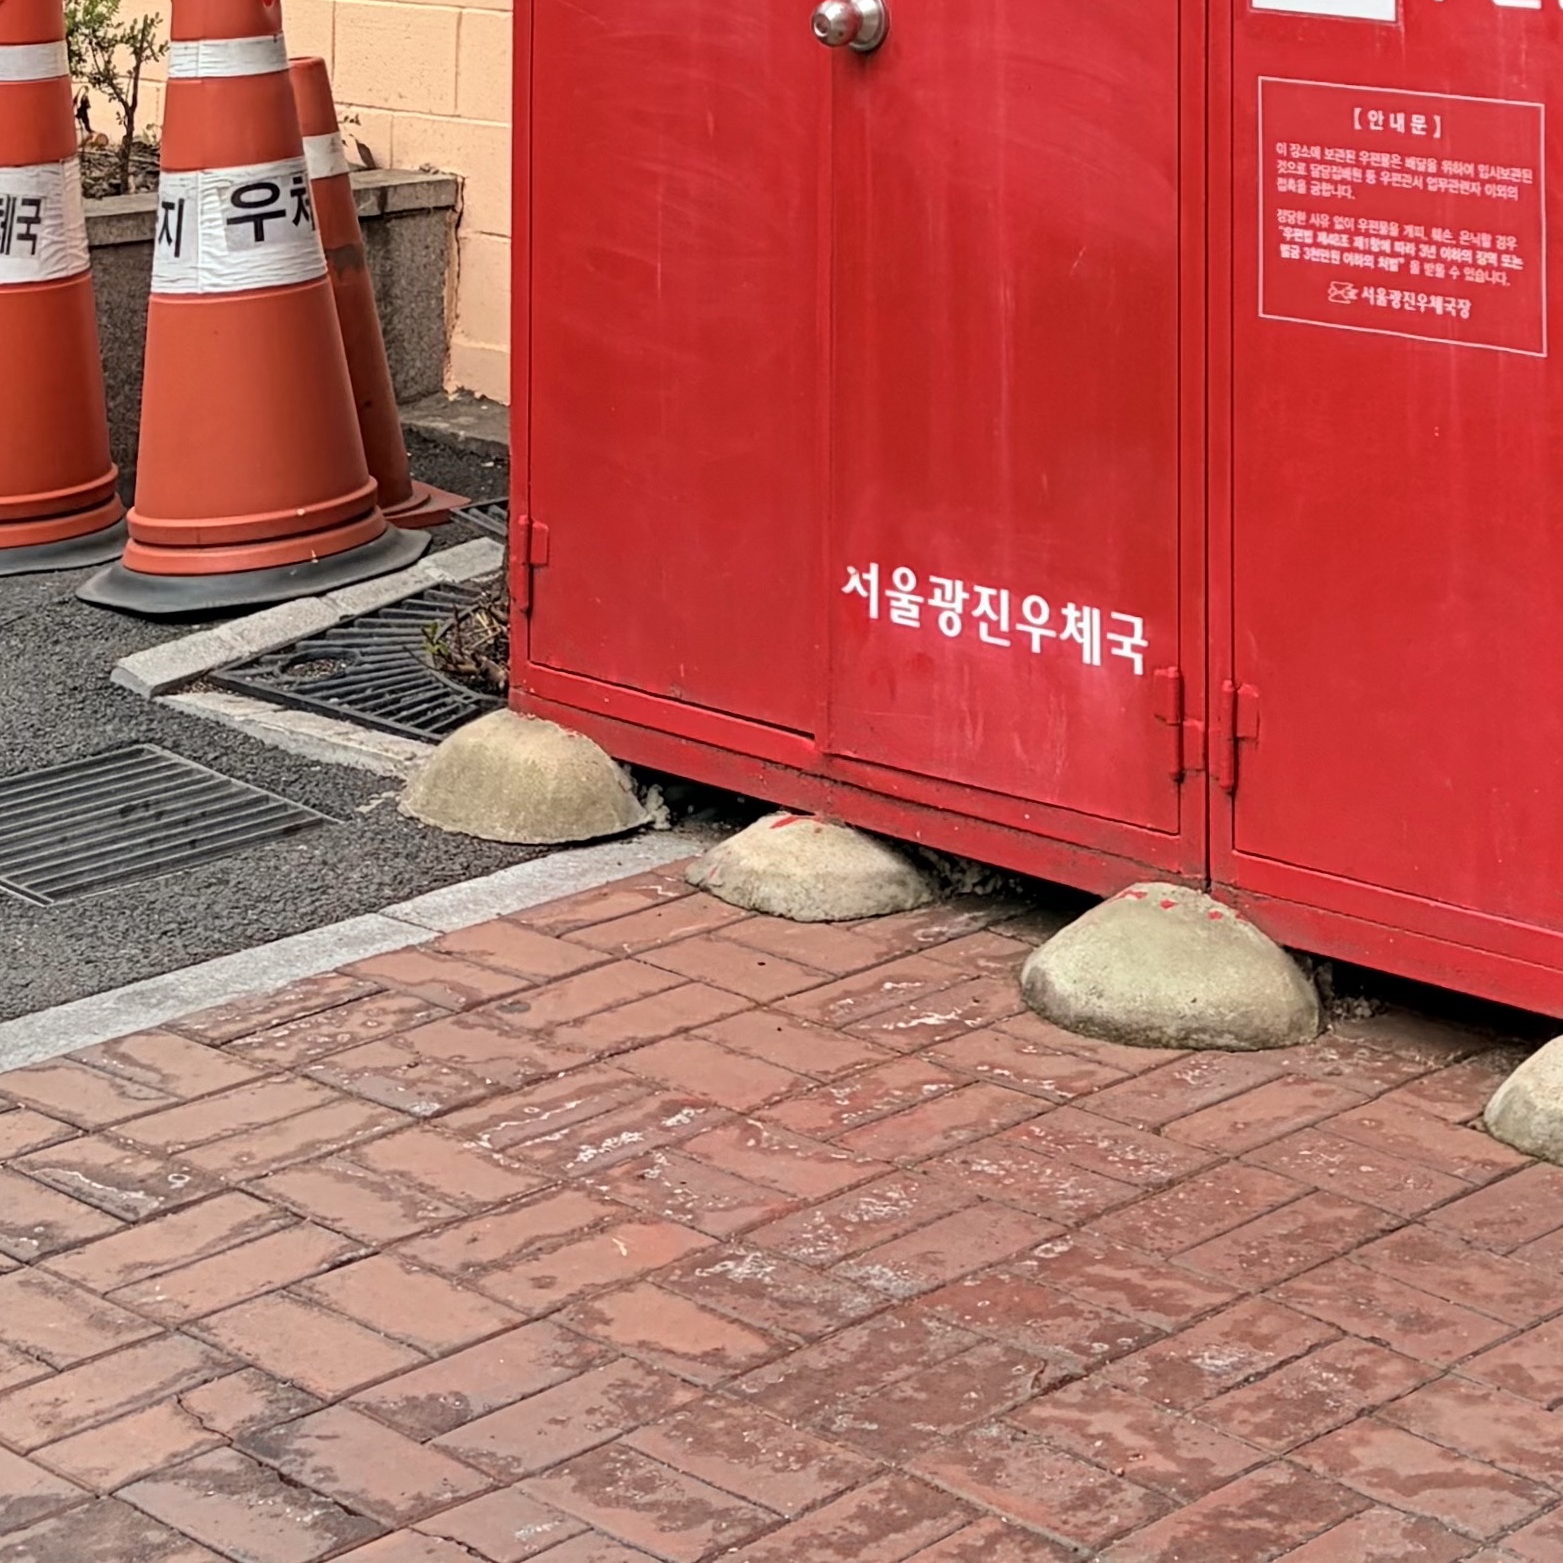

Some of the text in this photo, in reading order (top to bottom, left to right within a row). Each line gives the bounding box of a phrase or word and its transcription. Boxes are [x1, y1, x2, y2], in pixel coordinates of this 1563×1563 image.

[1276, 142, 1287, 156] 이
[1449, 265, 1460, 280] 수
[1360, 285, 1472, 320] 서울광진우체국장
[842, 563, 1148, 675] 서울광진우체국
